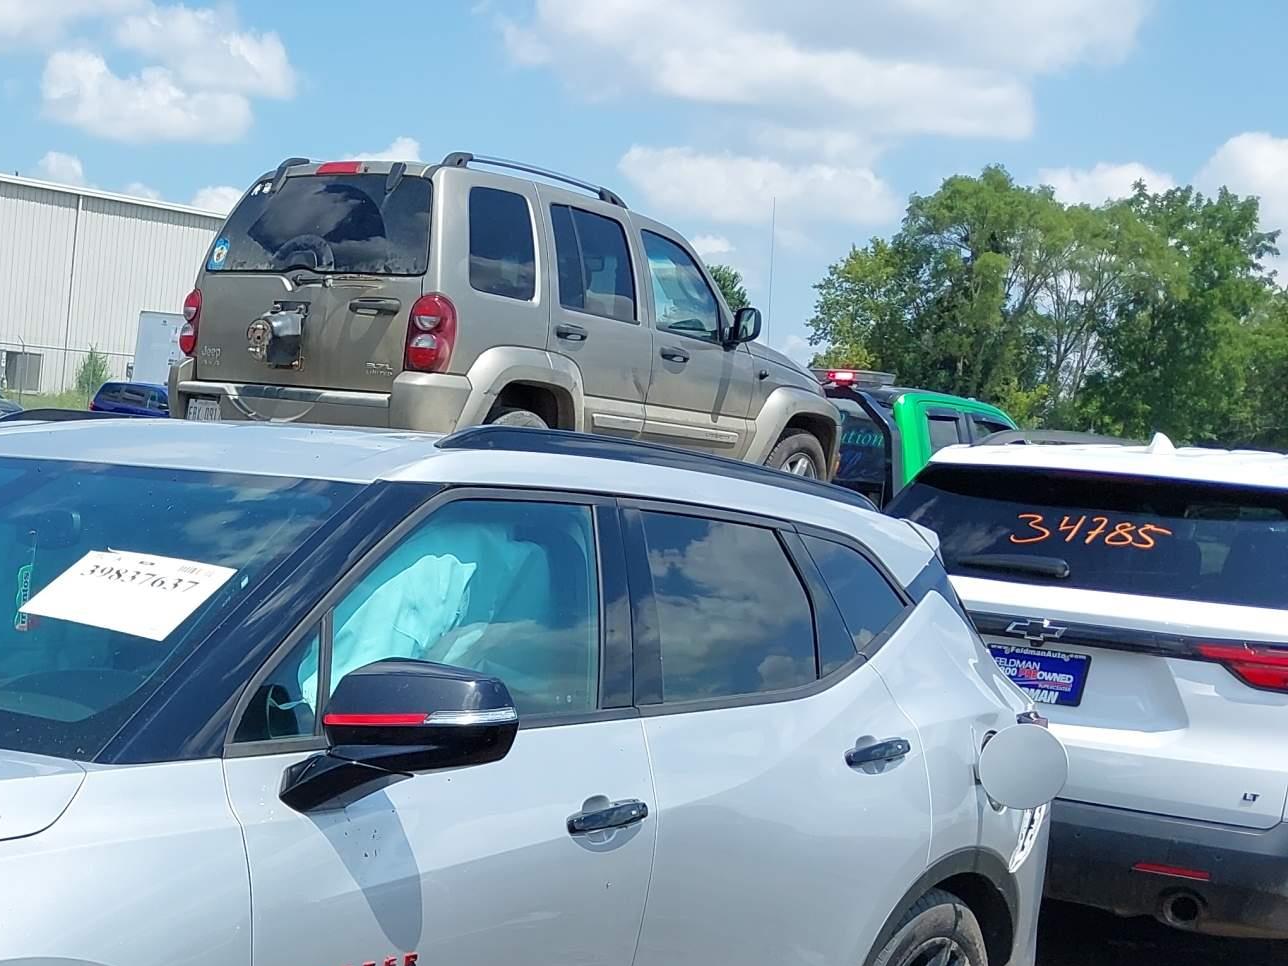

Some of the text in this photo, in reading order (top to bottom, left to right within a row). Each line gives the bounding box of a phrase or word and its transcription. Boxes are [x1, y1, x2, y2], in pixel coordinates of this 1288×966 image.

[201, 345, 221, 358] Jeep
[1010, 513, 1172, 548] 34785
[80, 564, 200, 593] 39837637
[20, 571, 30, 625] mntos
[994, 656, 1040, 670] FELDMAN
[1242, 792, 1260, 802] LT
